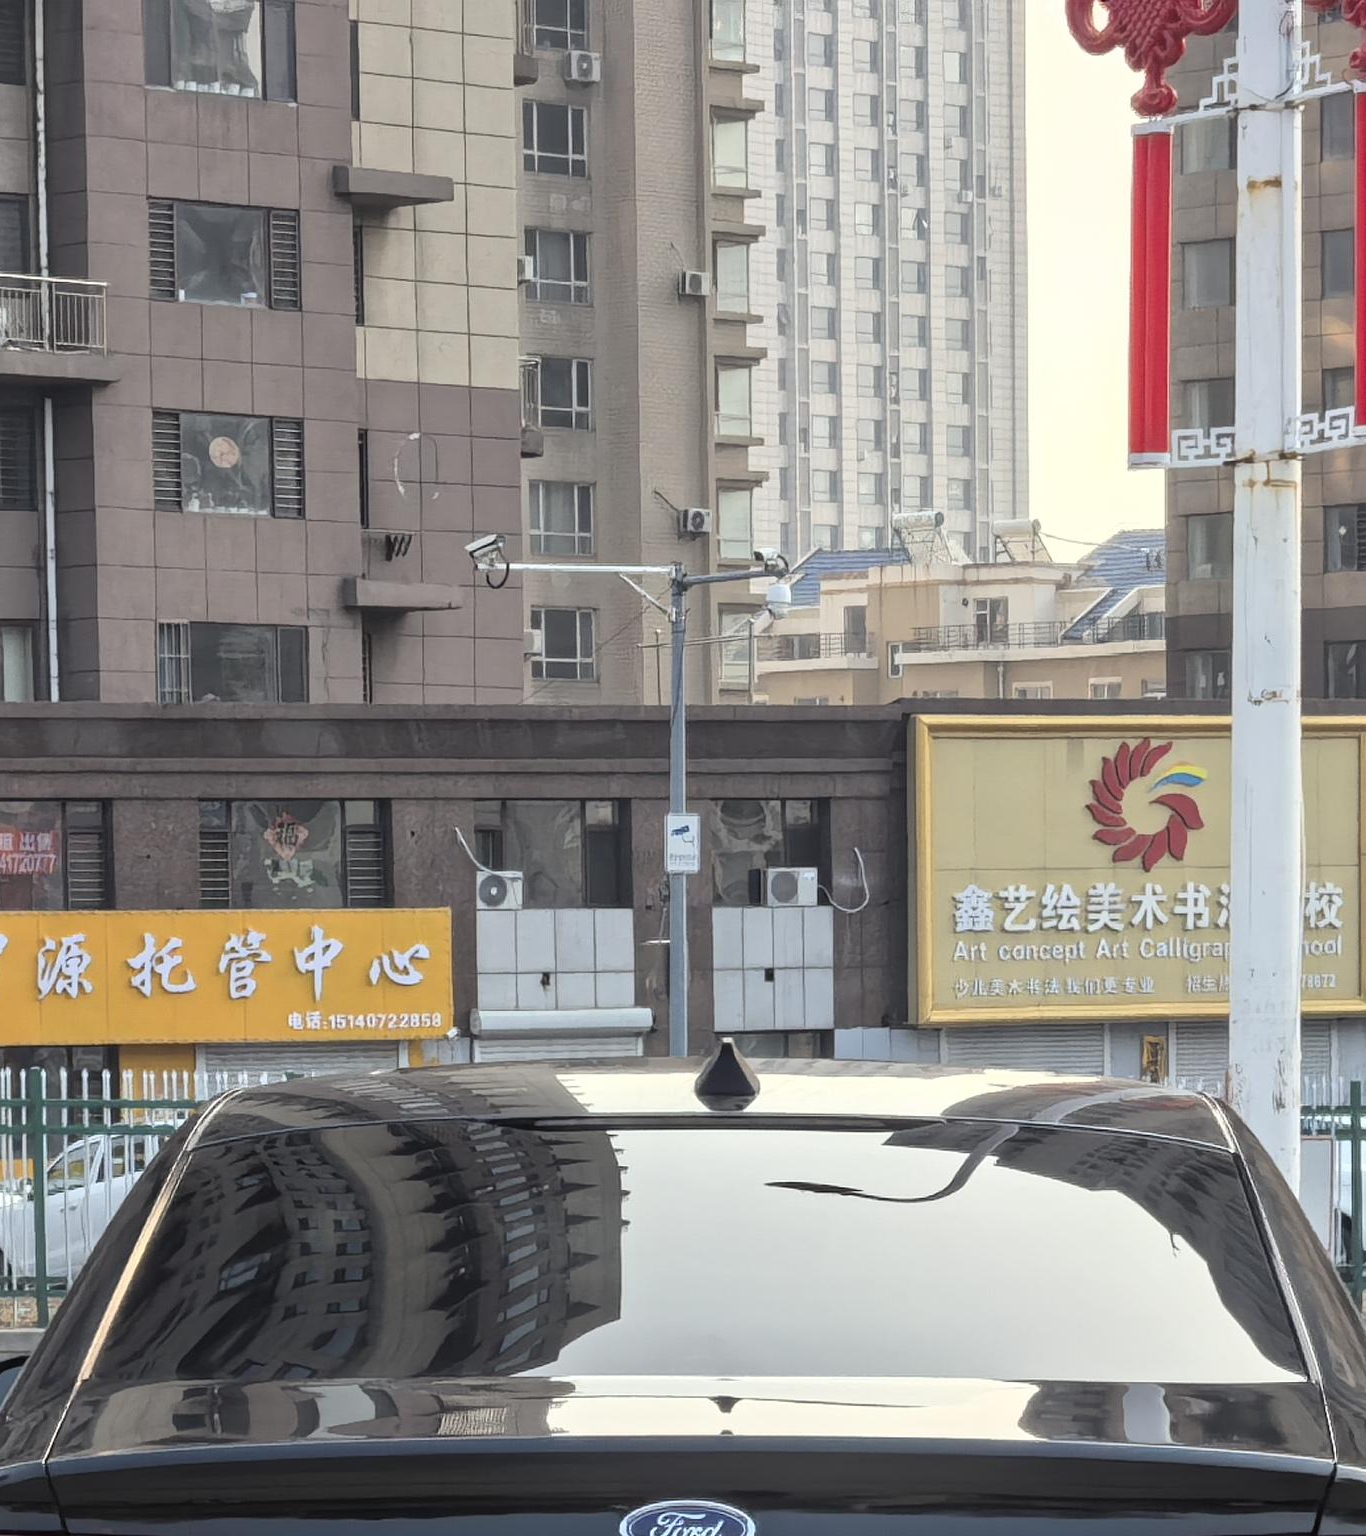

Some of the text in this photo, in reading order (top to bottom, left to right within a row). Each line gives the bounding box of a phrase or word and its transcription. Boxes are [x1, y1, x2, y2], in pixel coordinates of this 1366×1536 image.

[952, 882, 1345, 934] 鑫艺绘美术书校
[952, 940, 988, 962] Art
[998, 940, 1087, 966] concept
[1096, 937, 1130, 959] Art
